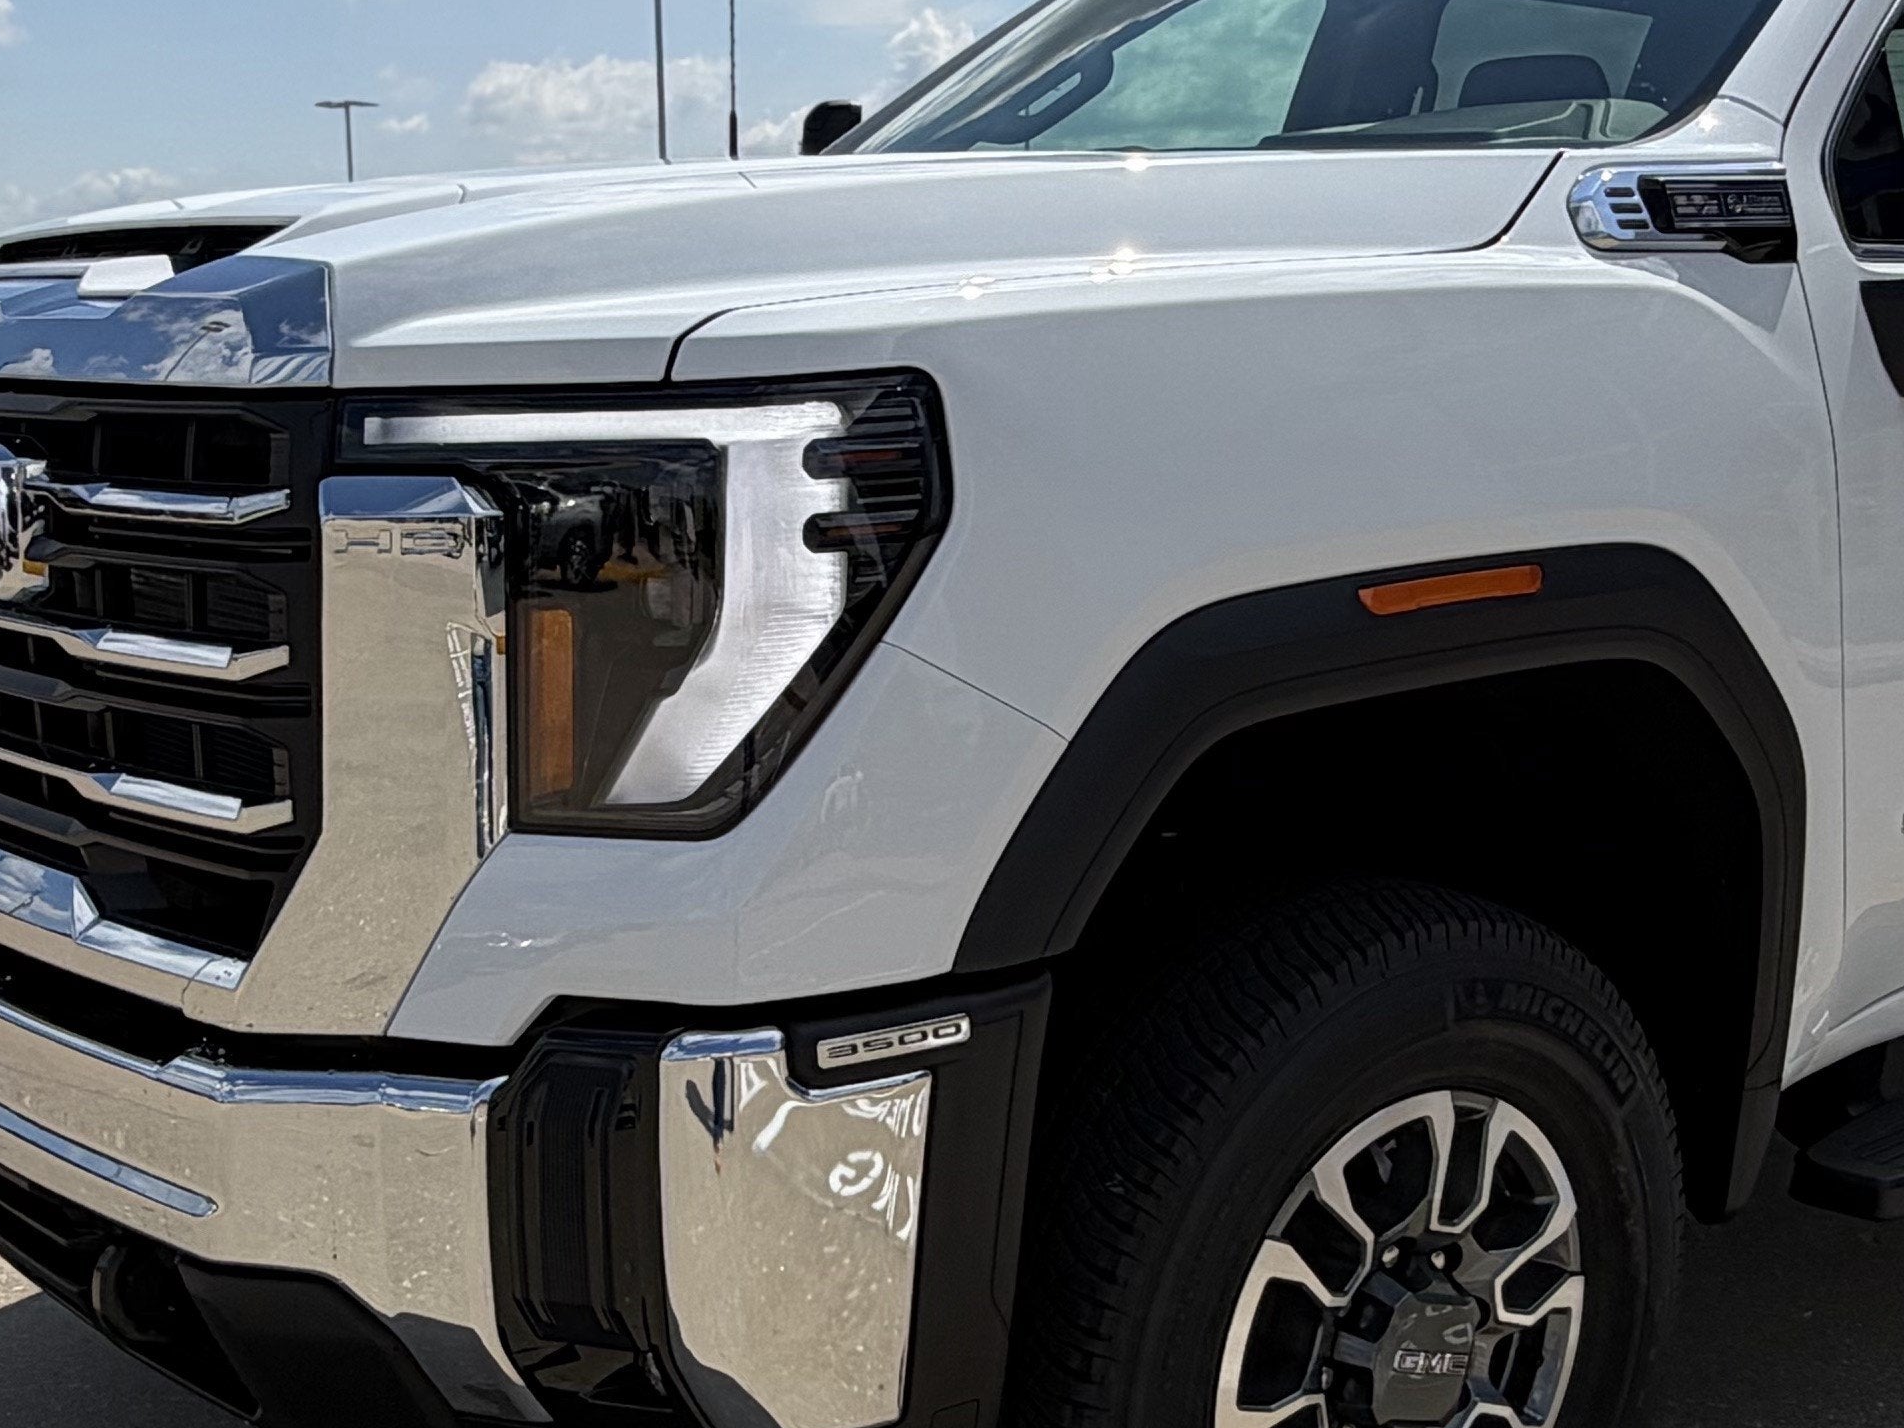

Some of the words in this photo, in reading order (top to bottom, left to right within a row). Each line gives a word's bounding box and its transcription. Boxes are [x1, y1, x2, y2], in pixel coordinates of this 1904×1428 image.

[826, 1021, 962, 1059] 3500
[1498, 981, 1636, 1095] MICHELIN
[1393, 1348, 1470, 1375] GMC
